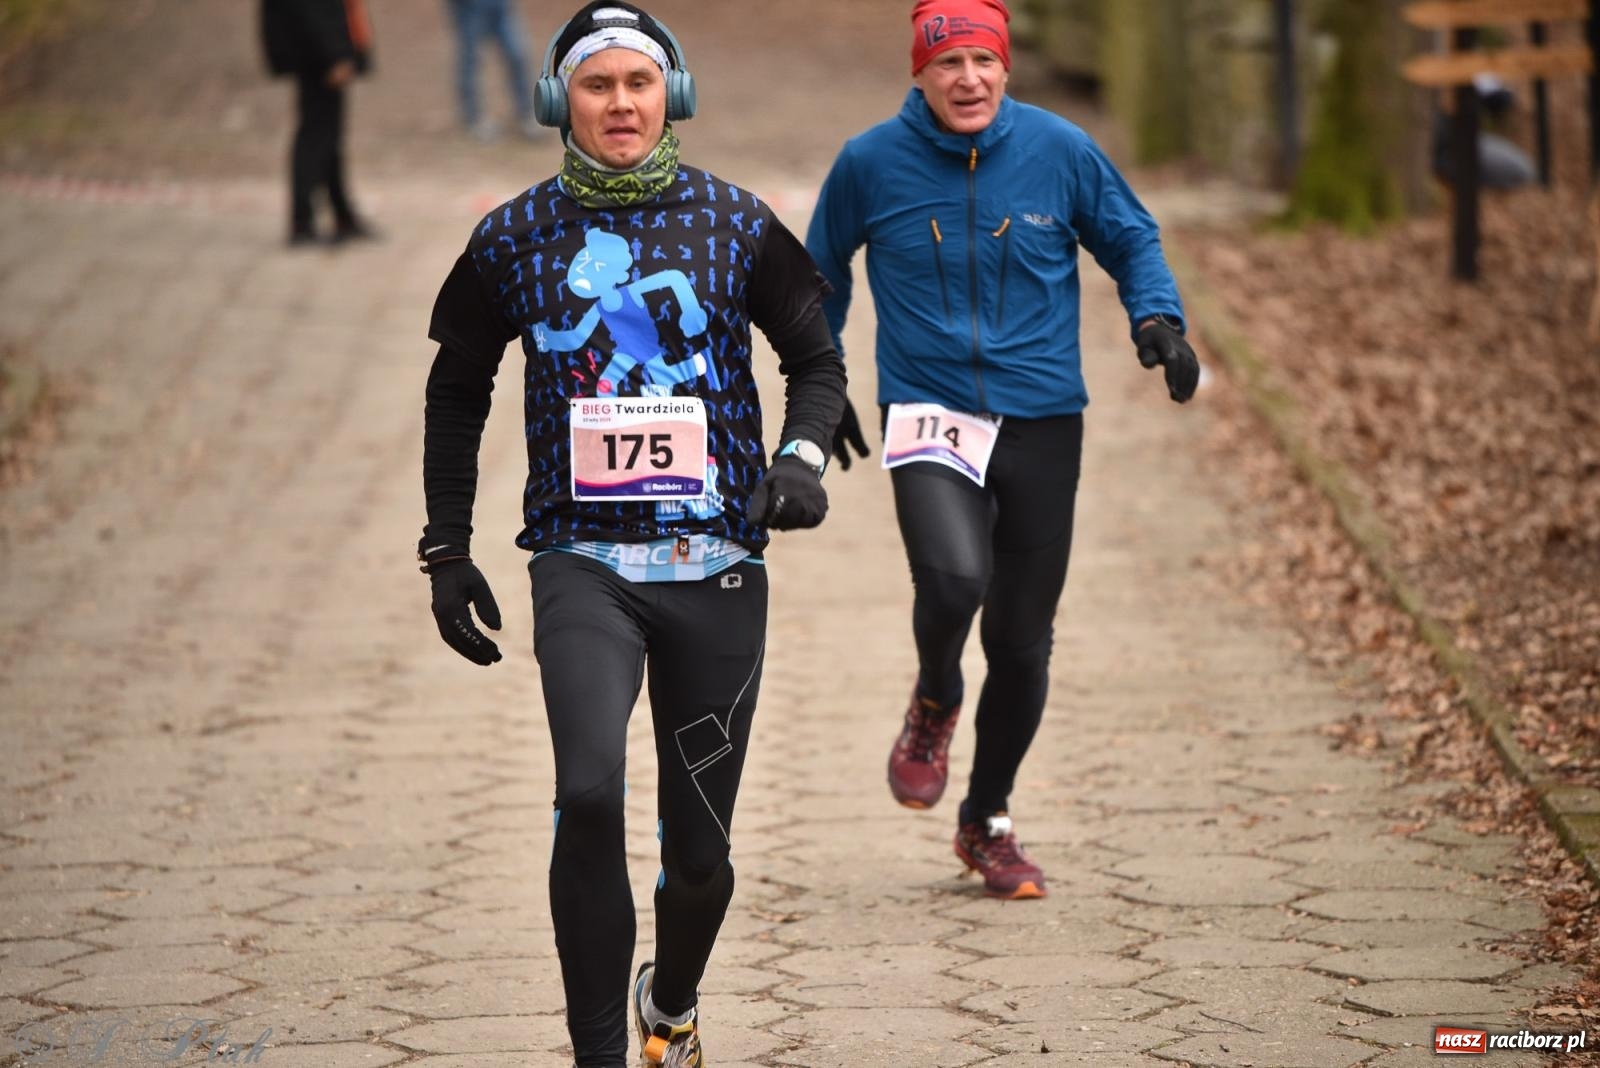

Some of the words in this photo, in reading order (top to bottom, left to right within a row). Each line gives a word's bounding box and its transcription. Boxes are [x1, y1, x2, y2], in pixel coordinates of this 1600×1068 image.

[923, 15, 947, 48] 12
[582, 404, 611, 415] BIEG
[615, 402, 694, 415] Twardziela
[916, 415, 961, 449] 114
[602, 433, 674, 470] 175
